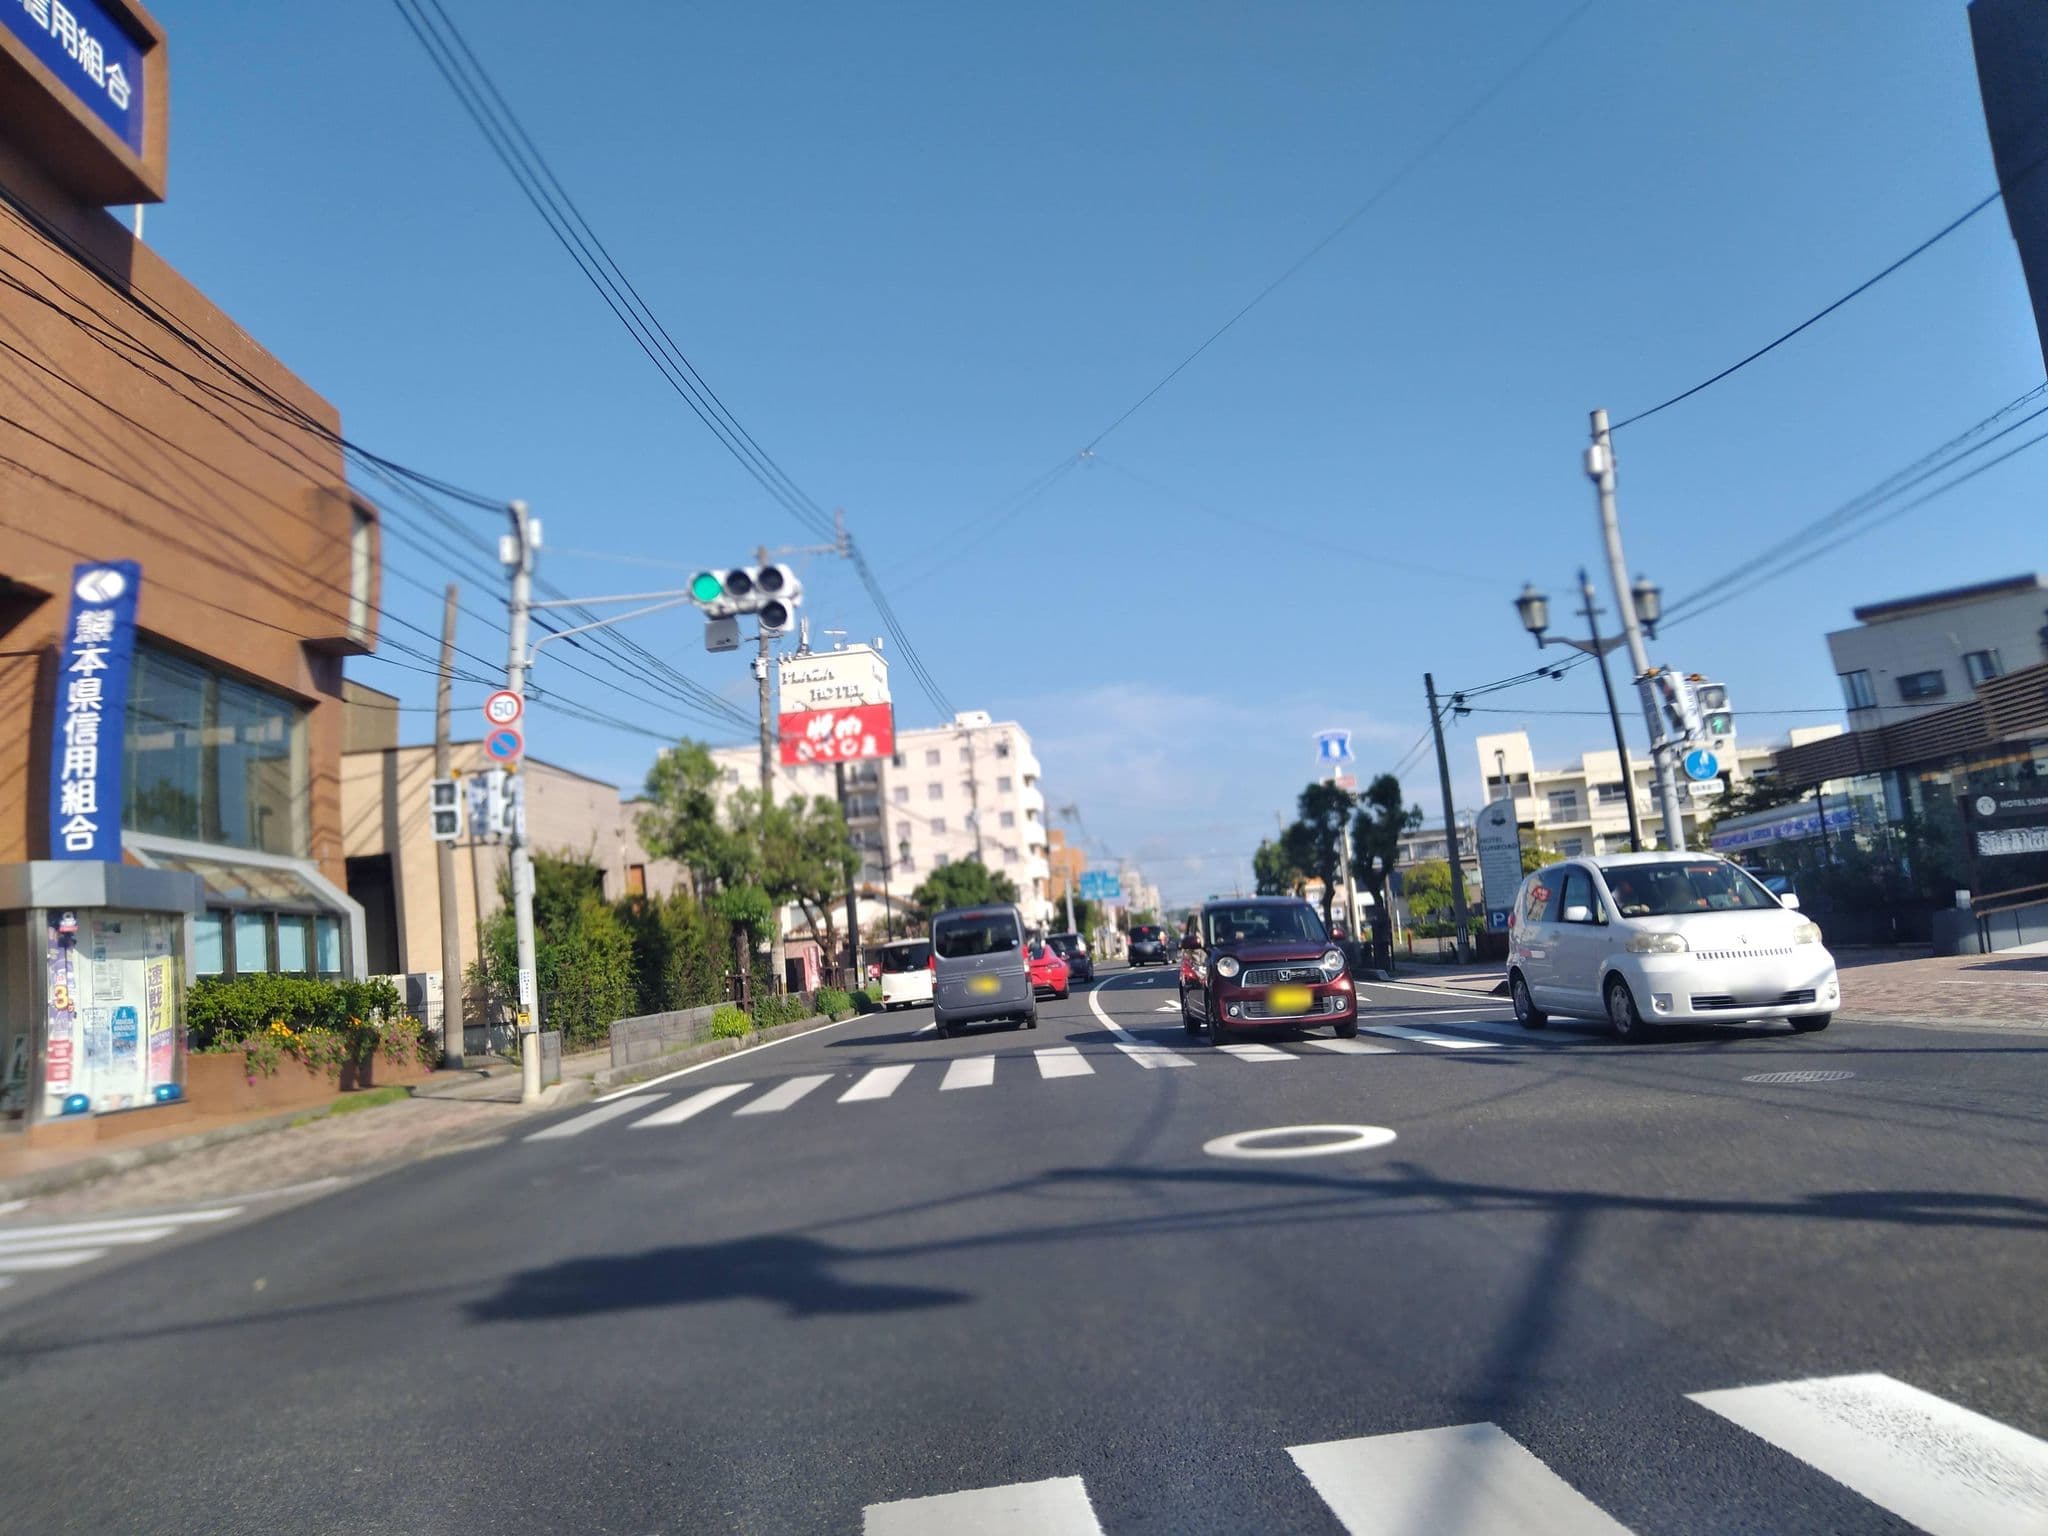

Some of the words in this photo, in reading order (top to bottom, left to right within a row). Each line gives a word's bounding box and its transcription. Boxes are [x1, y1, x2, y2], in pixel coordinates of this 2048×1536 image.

[493, 701, 515, 717] 50
[60, 609, 116, 852] 熊本県信用組合
[1492, 912, 1506, 928] P
